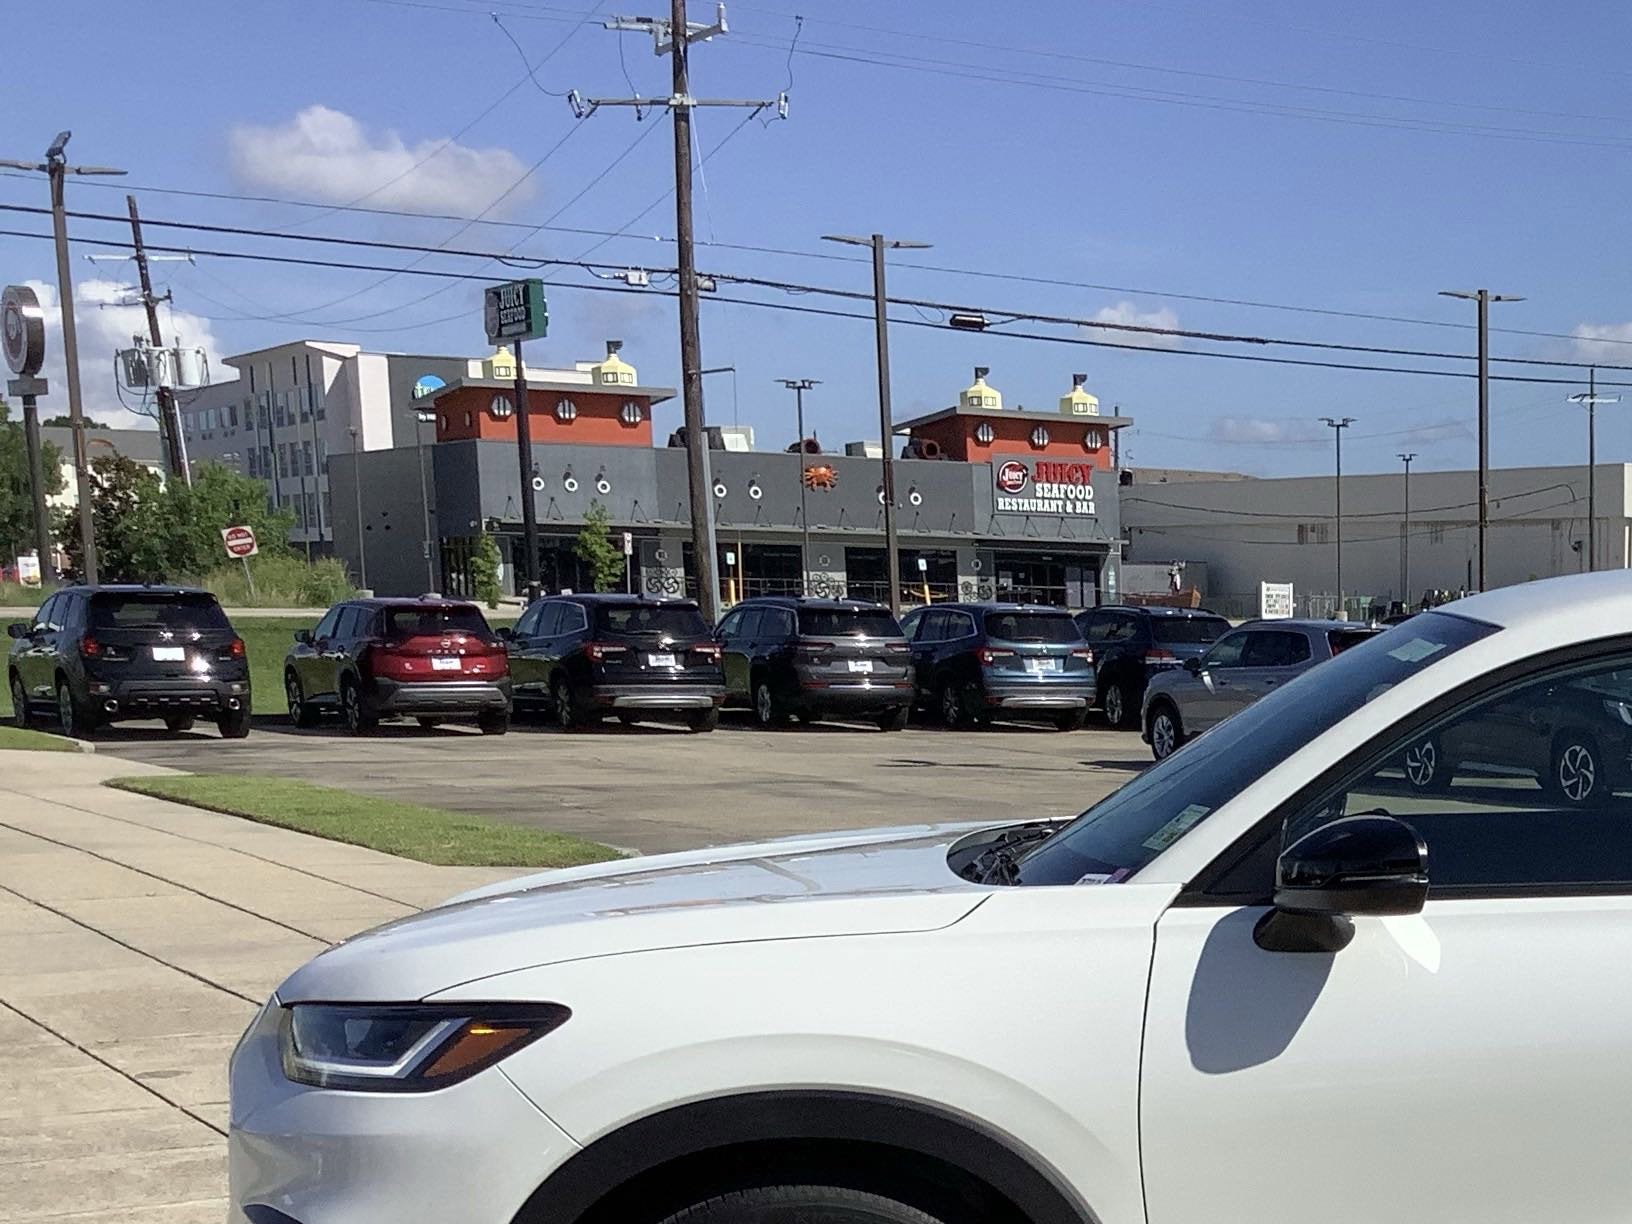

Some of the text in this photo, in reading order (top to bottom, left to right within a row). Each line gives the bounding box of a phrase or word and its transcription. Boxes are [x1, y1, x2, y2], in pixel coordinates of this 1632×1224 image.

[1031, 462, 1092, 484] JUICY
[1035, 483, 1094, 500] SEAFOOD
[997, 498, 1095, 515] RESTAURANT & BAR
